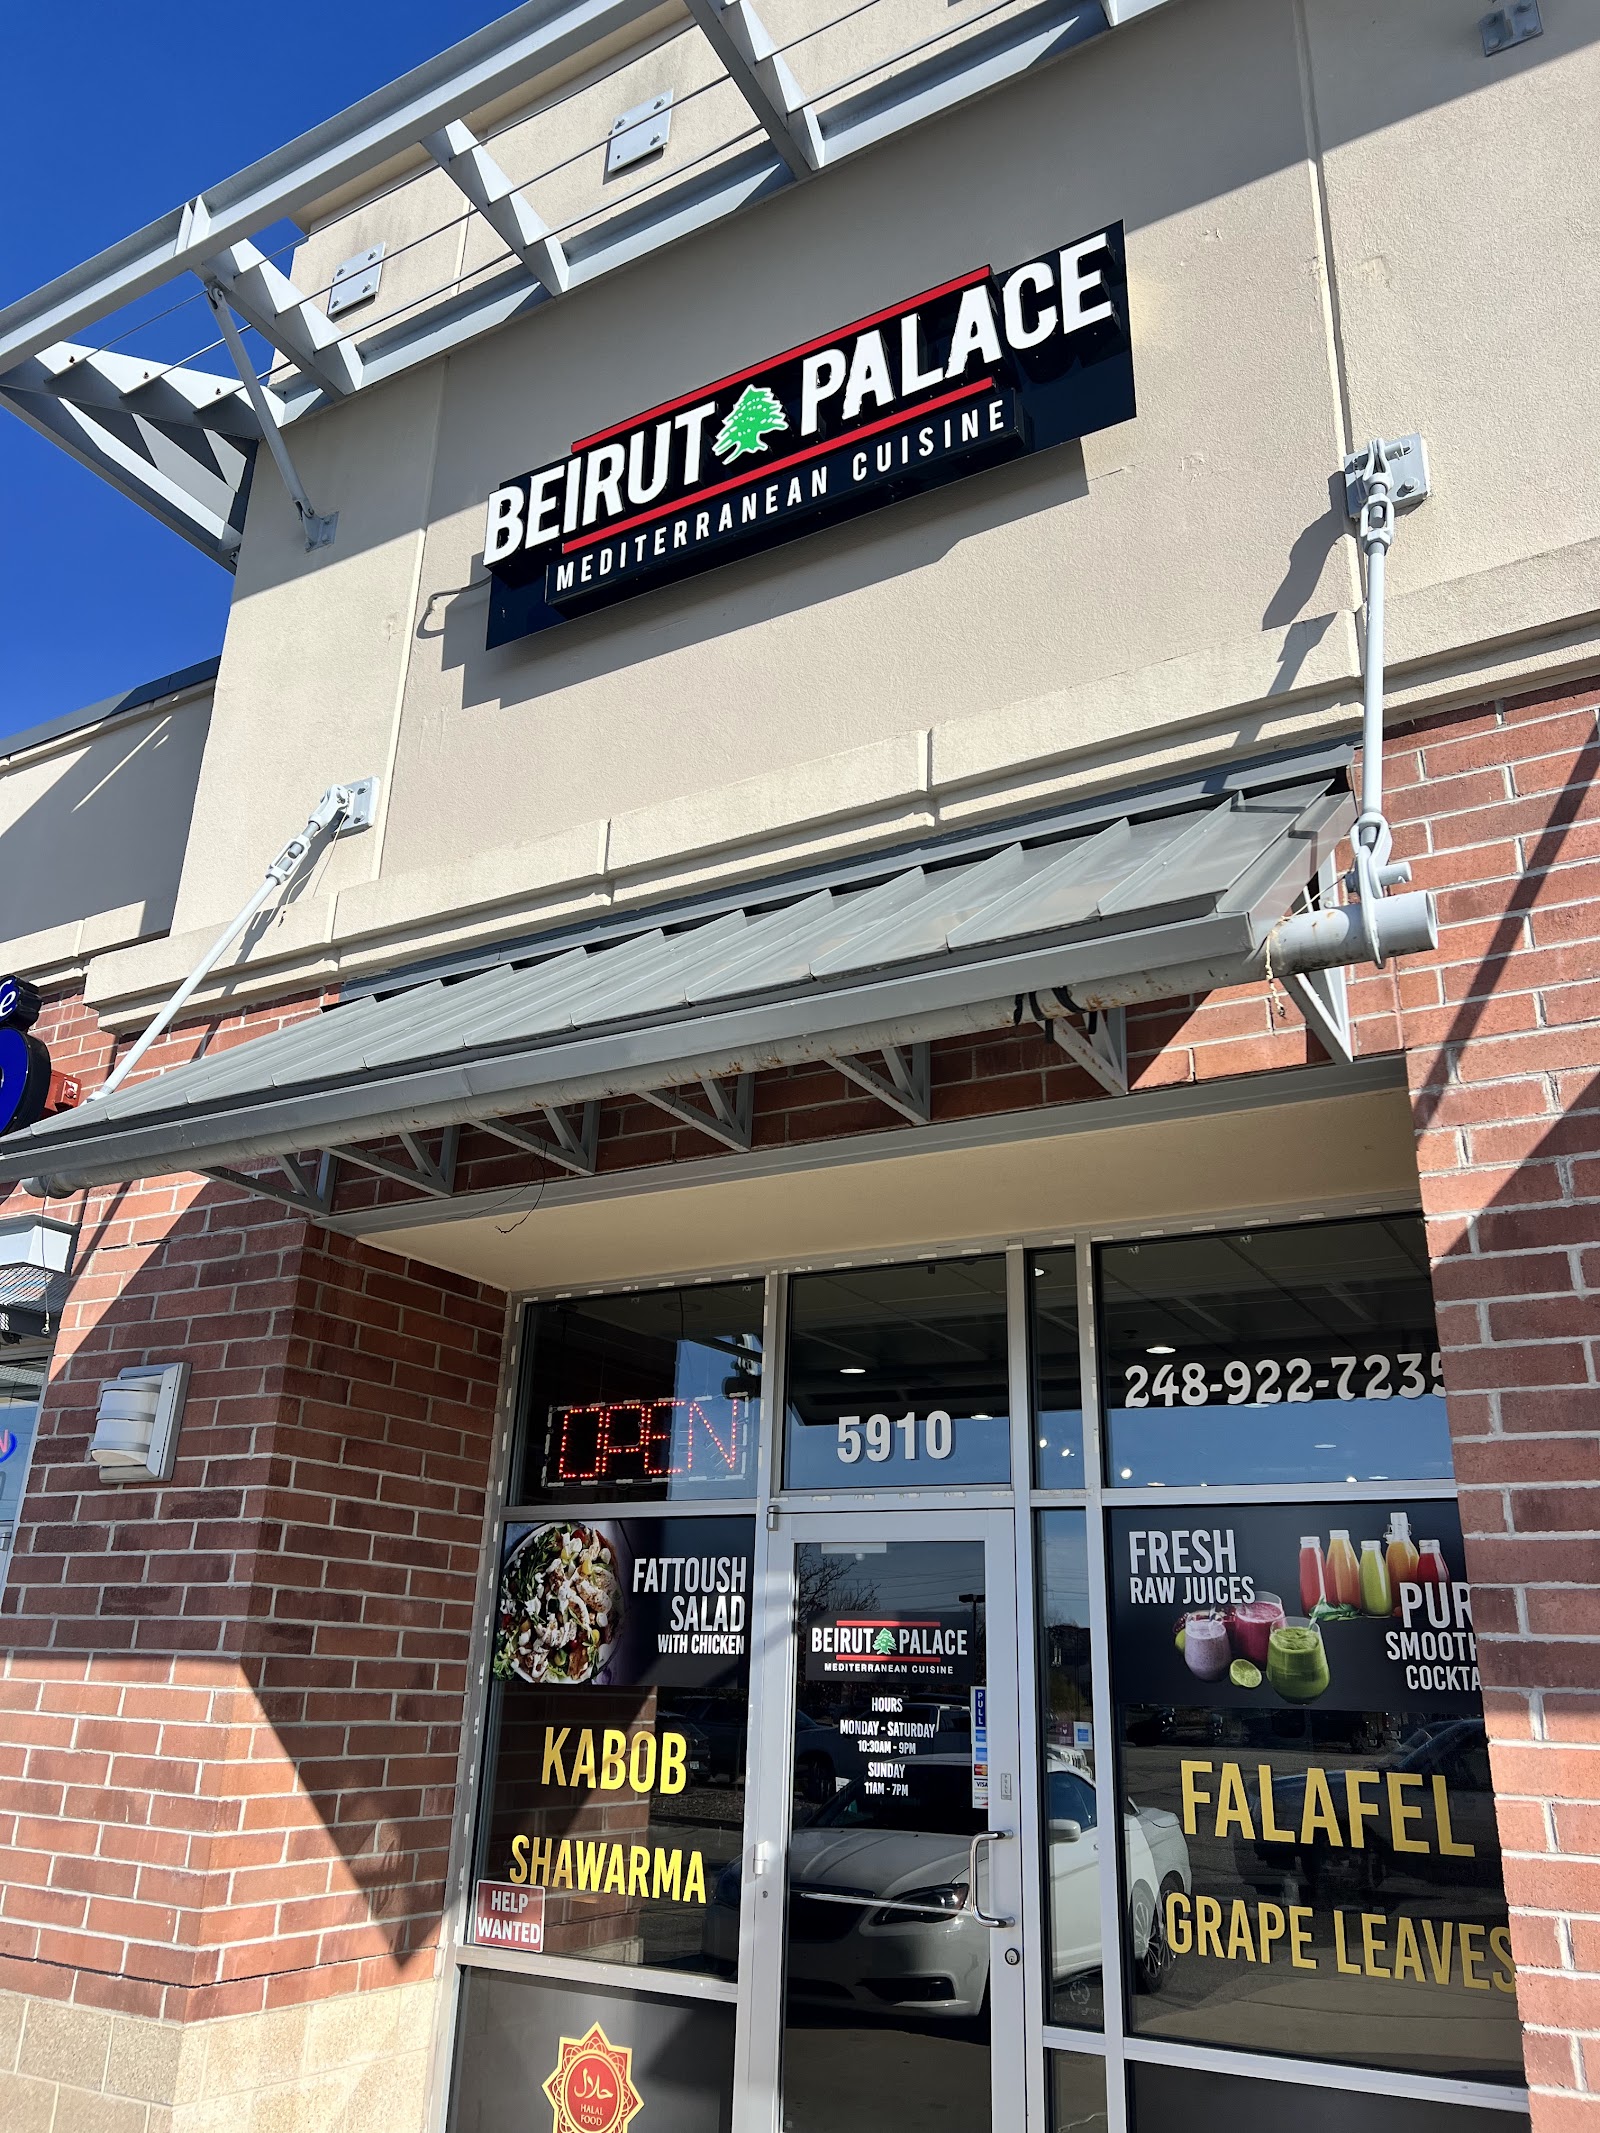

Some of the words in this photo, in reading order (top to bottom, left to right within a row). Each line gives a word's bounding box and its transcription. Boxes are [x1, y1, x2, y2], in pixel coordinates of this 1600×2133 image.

[482, 402, 716, 567] BEIRUT
[800, 232, 1114, 436] PALACE
[555, 465, 828, 592] MEDITERRANEAN
[851, 399, 1006, 481] CUISINE
[557, 1398, 738, 1479] OPEN
[836, 1409, 953, 1465] 5910
[1128, 1529, 1237, 1574] FRESH
[632, 1556, 747, 1593] FATTOUSH
[1129, 1576, 1176, 1604] RAW
[1182, 1575, 1256, 1605] JUICES
[670, 1595, 746, 1632] SALAD
[657, 1634, 689, 1654] WITH
[690, 1633, 745, 1655] CHICKEN
[811, 1627, 874, 1653] BEIRUT
[899, 1628, 968, 1656] PALACE
[824, 1662, 908, 1674] MEDITERRANEAN
[911, 1664, 954, 1675] CUISINE
[871, 1697, 903, 1713] HOURS
[840, 1719, 880, 1736] MONDAY
[887, 1721, 936, 1739] SATURDAY
[541, 1726, 688, 1794] KABOB
[857, 1740, 892, 1754] 10:30AM
[898, 1741, 917, 1755] 9PM
[867, 1761, 906, 1779] SUNDAY
[864, 1781, 885, 1795] 11AM
[892, 1783, 909, 1797] 7PM
[1180, 1760, 1475, 1857] FALAFEL
[509, 1834, 707, 1904] SHAWARMA
[491, 1889, 529, 1914] HELP
[477, 1916, 541, 1944] WANTED
[1165, 1892, 1318, 1970] GRAPE
[1334, 1909, 1516, 1994] LEAVES
[573, 2067, 614, 2100] حلال
[580, 2103, 604, 2116] HALAL
[580, 2114, 603, 2126] FOOD
